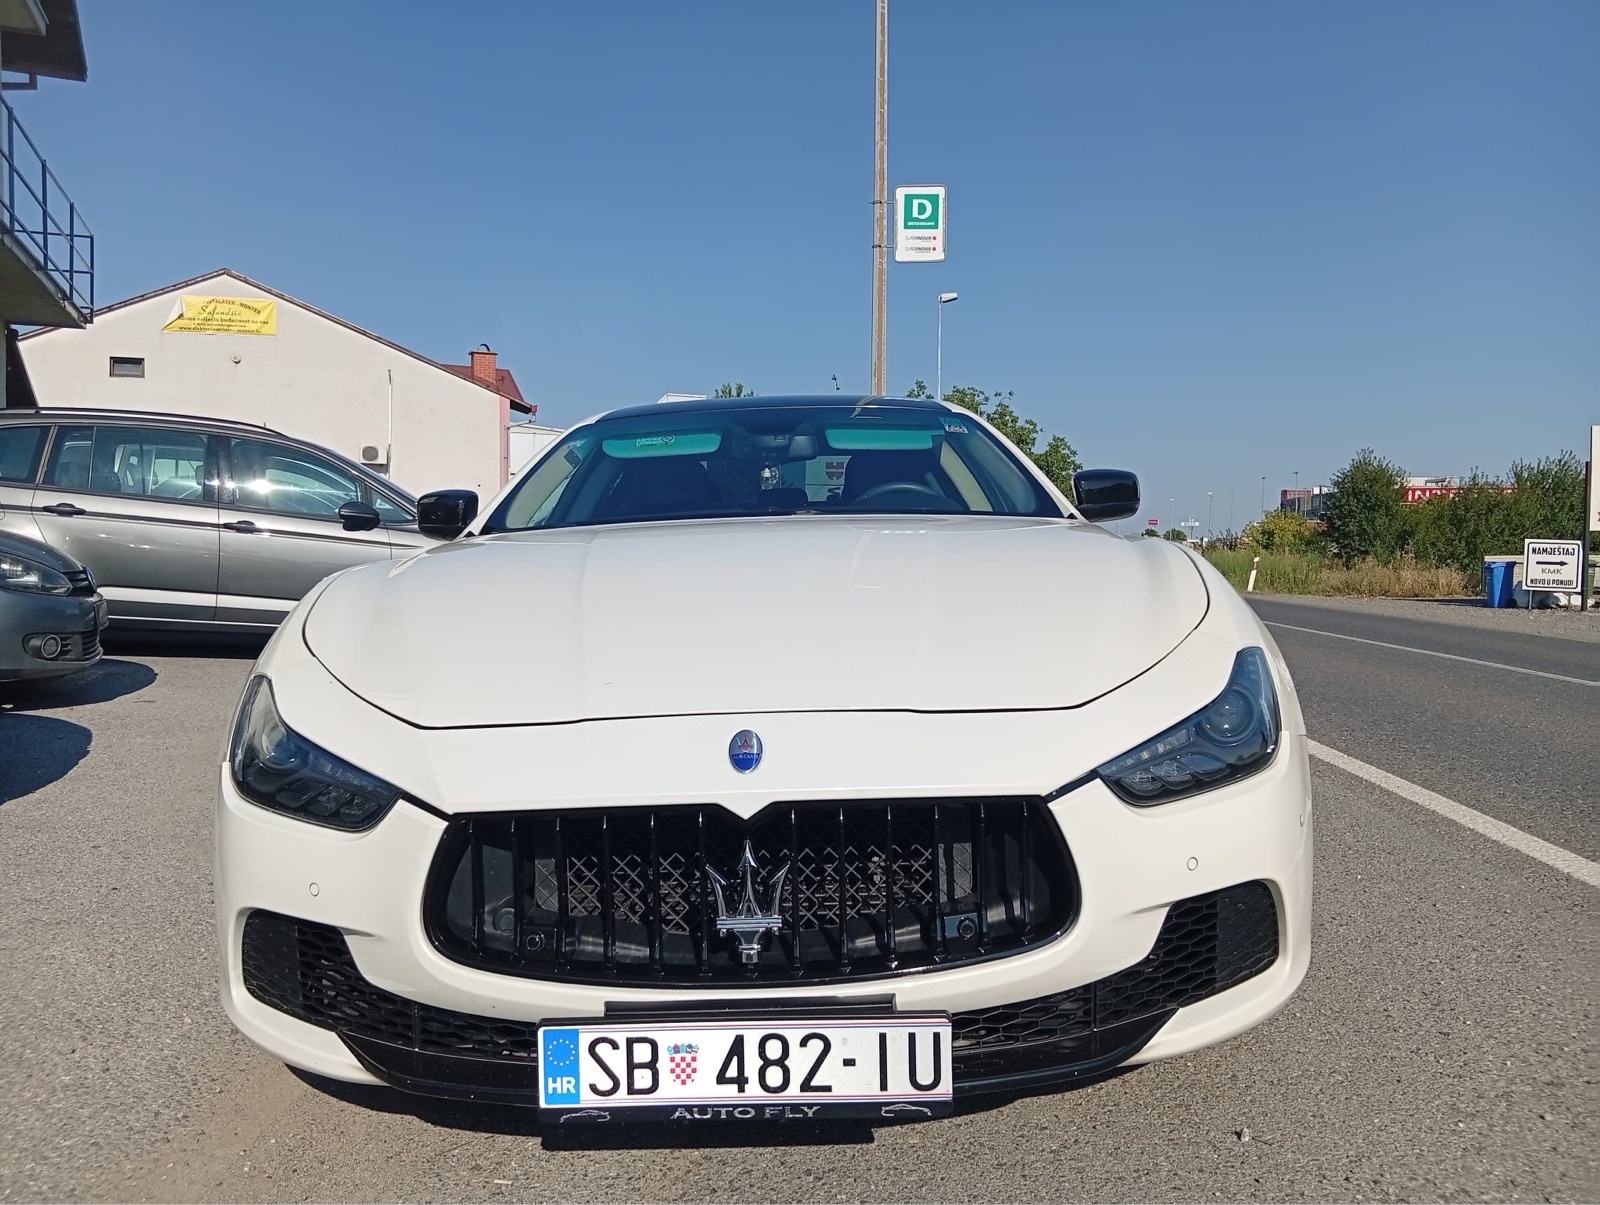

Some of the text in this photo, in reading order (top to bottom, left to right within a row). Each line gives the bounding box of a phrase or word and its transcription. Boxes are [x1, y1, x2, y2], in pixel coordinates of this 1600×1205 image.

[912, 198, 932, 220] D
[239, 302, 262, 315] MONTER
[1531, 546, 1575, 556] NAMJEŠTAJ
[1541, 567, 1563, 575] KMK
[1530, 578, 1546, 586] NOVO
[588, 1035, 660, 1097] SB
[547, 1076, 577, 1095] HR
[671, 1104, 823, 1120] AUTO FLY
